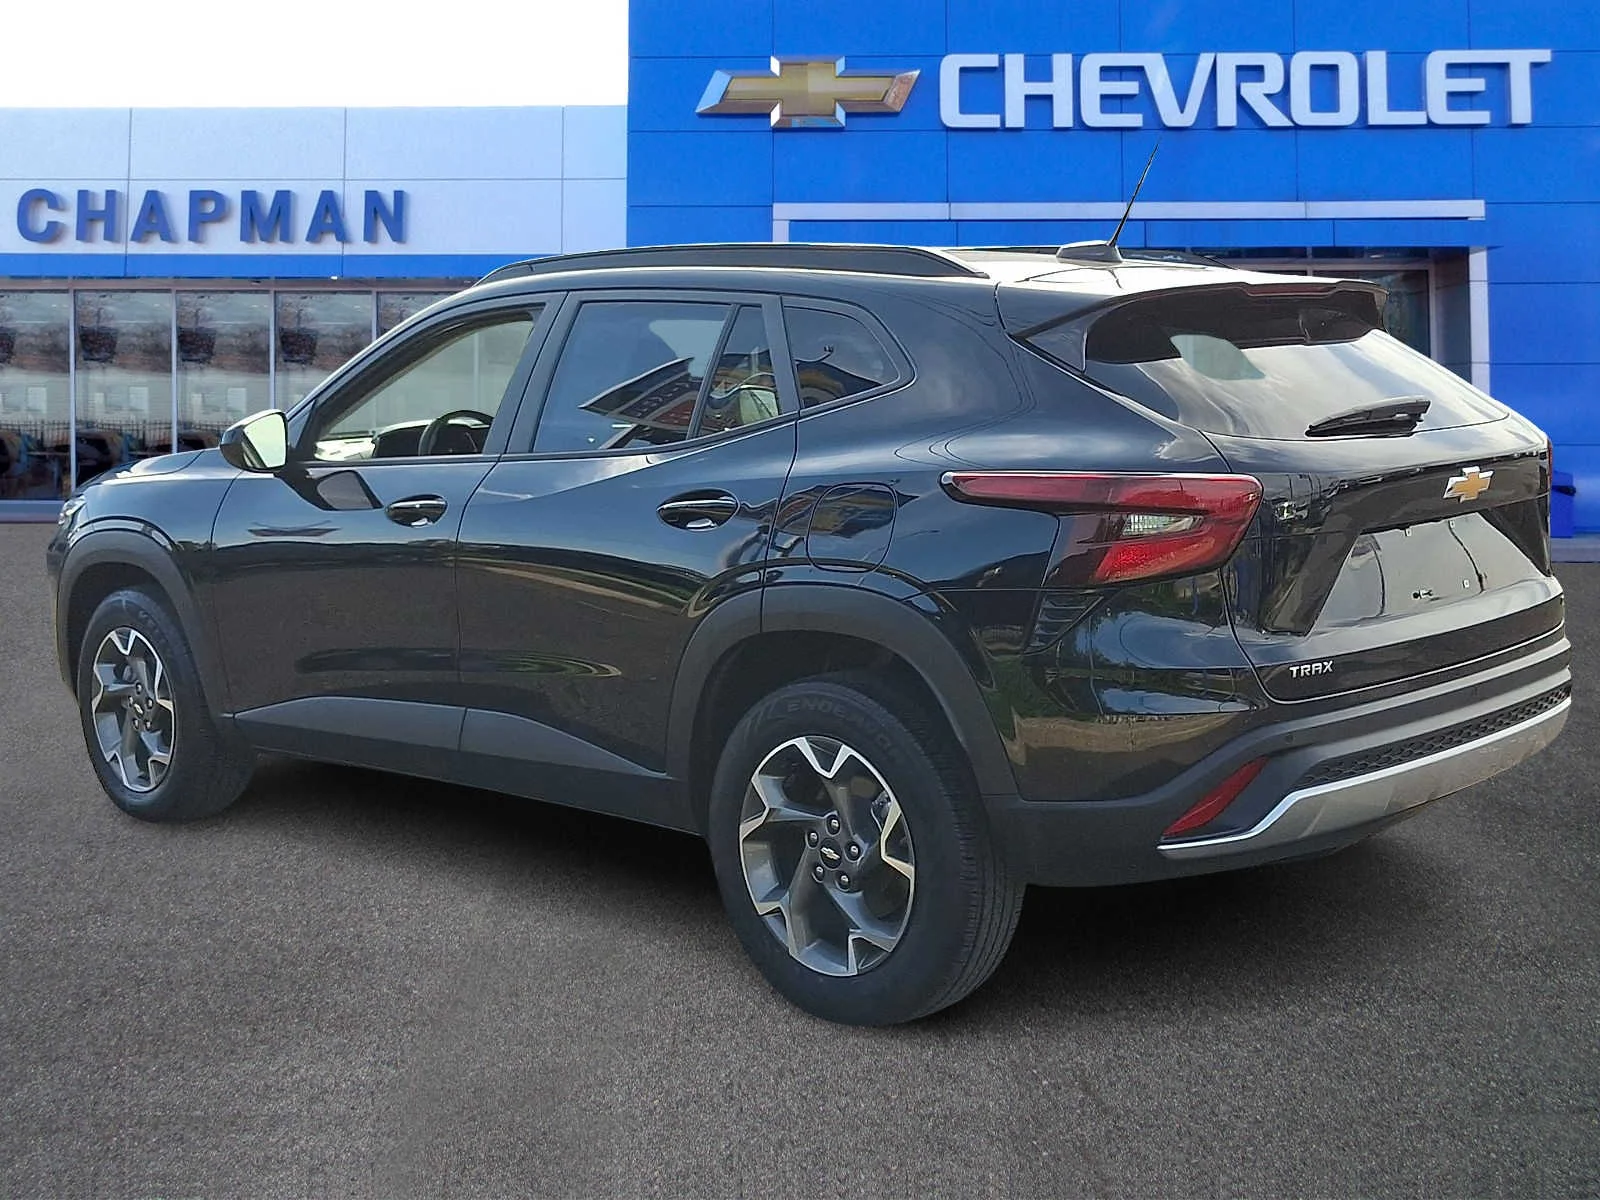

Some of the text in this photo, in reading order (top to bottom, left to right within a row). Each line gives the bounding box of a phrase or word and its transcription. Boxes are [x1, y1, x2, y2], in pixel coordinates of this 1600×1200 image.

[939, 49, 1552, 129] CHEVROLET
[16, 188, 408, 244] CHAPMAN
[1289, 660, 1333, 678] TRAX
